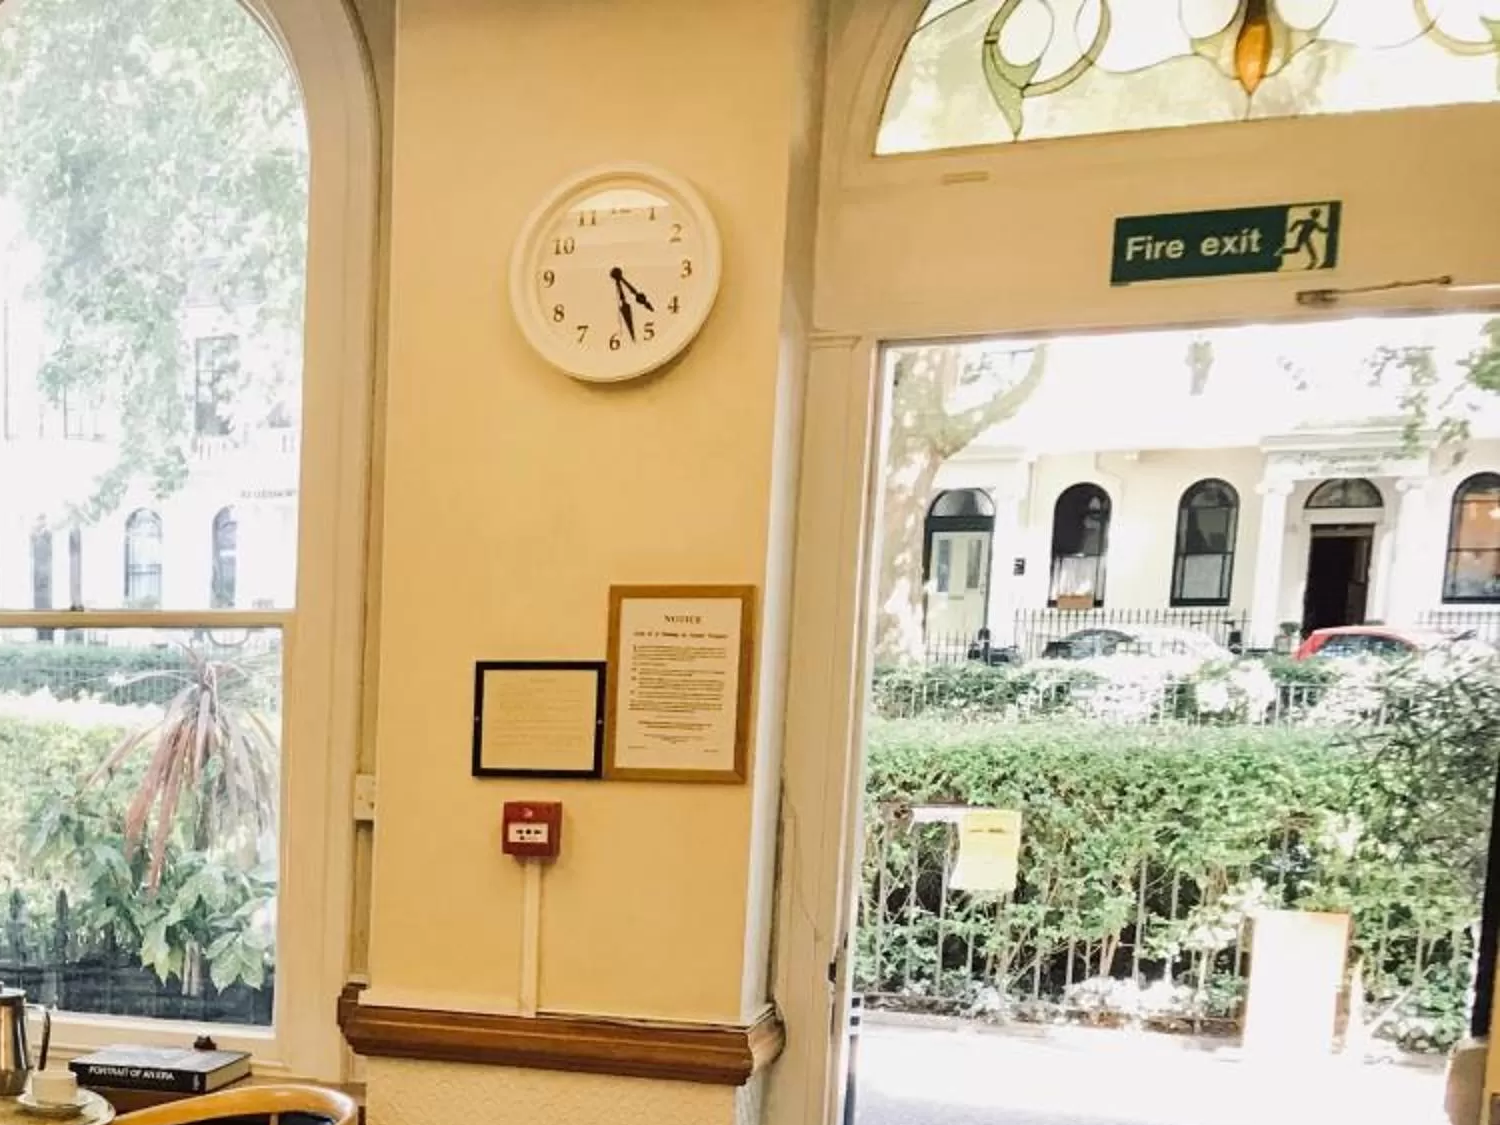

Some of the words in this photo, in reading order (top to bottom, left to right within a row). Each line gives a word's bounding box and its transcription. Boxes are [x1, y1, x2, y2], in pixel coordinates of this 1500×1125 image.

[577, 209, 597, 227] 11
[668, 223, 683, 243] 2
[553, 236, 576, 256] 10
[1125, 234, 1185, 262] Fire
[1199, 227, 1263, 256] exit
[681, 259, 693, 279] 3
[543, 270, 555, 288] 9
[552, 304, 566, 322] 8
[667, 295, 681, 315] 4
[576, 324, 589, 344] 7
[642, 322, 656, 341] 5
[609, 333, 620, 350] 6
[89, 1065, 129, 1077] PORTRAIT
[129, 1069, 142, 1078] OF
[143, 1070, 155, 1080] AN
[156, 1071, 175, 1081] ERA
